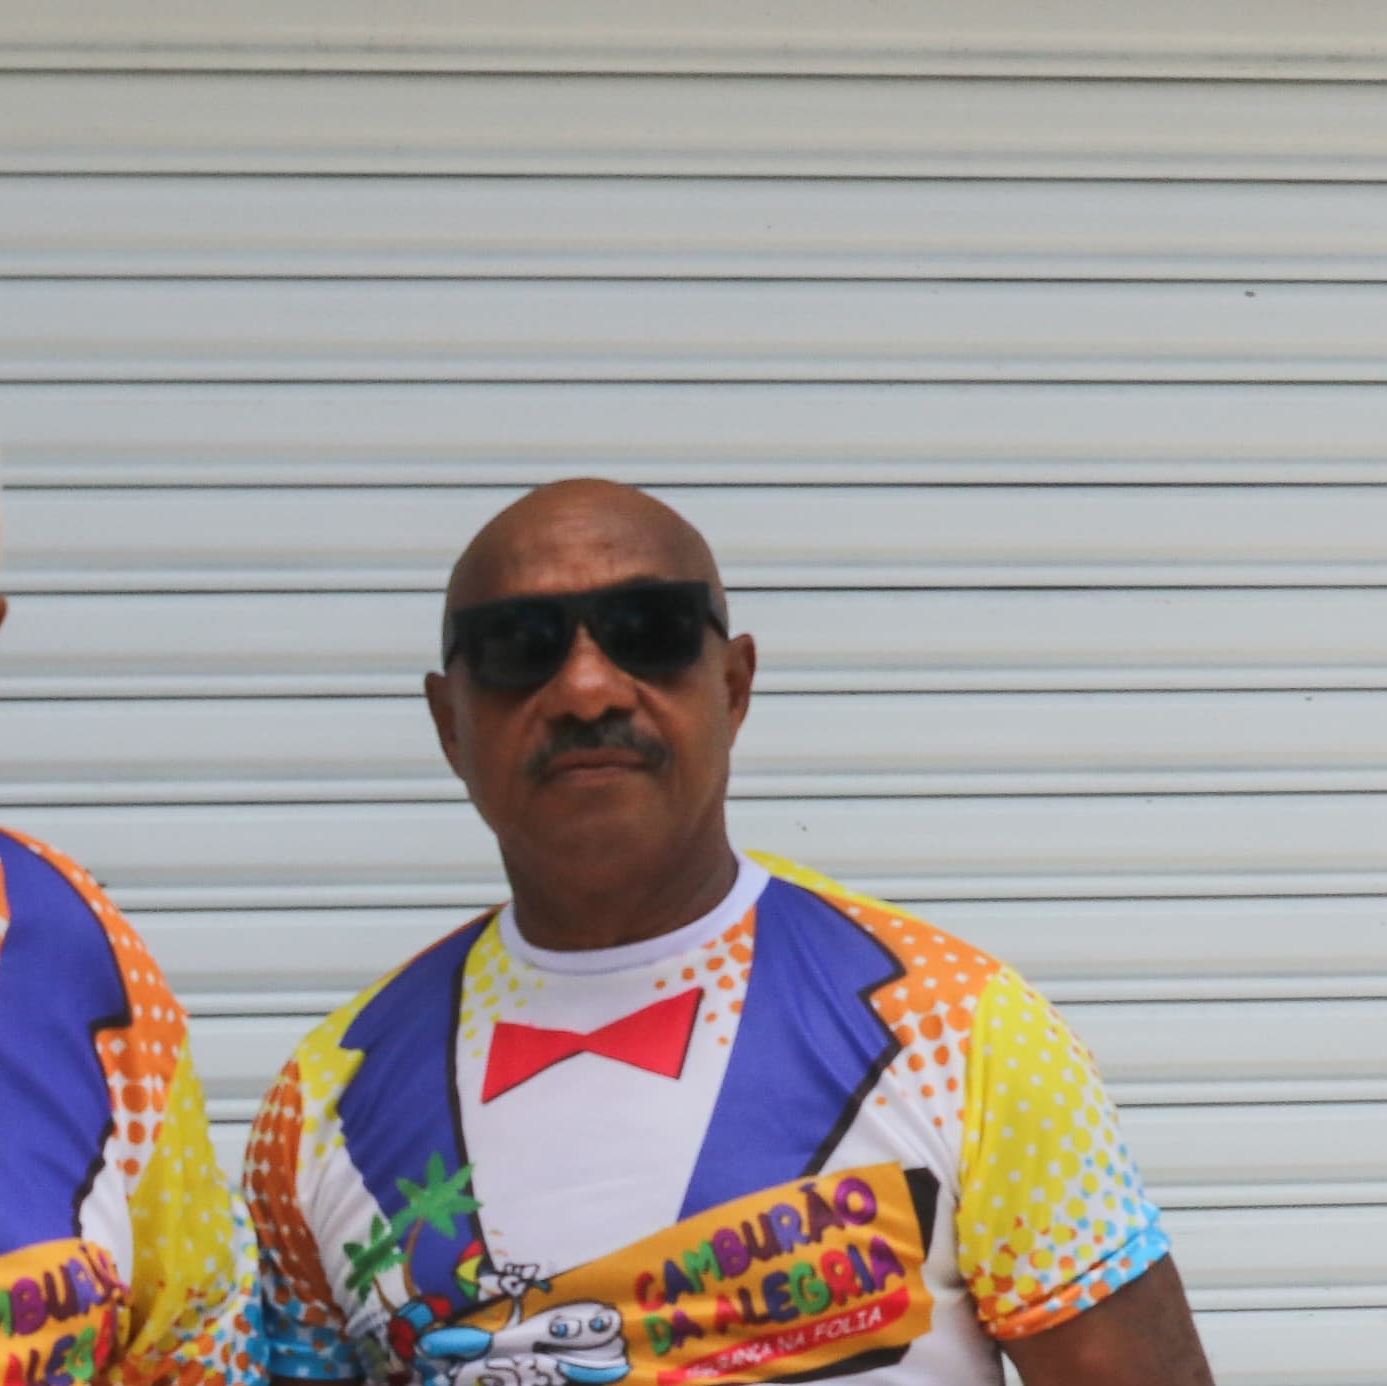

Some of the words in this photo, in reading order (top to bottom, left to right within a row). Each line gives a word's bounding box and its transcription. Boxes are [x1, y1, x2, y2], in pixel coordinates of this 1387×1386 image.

[634, 1176, 877, 1312] CAMBURÃO
[644, 1310, 705, 1357] DA
[713, 1234, 906, 1335] ALEGRIA
[813, 1305, 883, 1341] FOLIA
